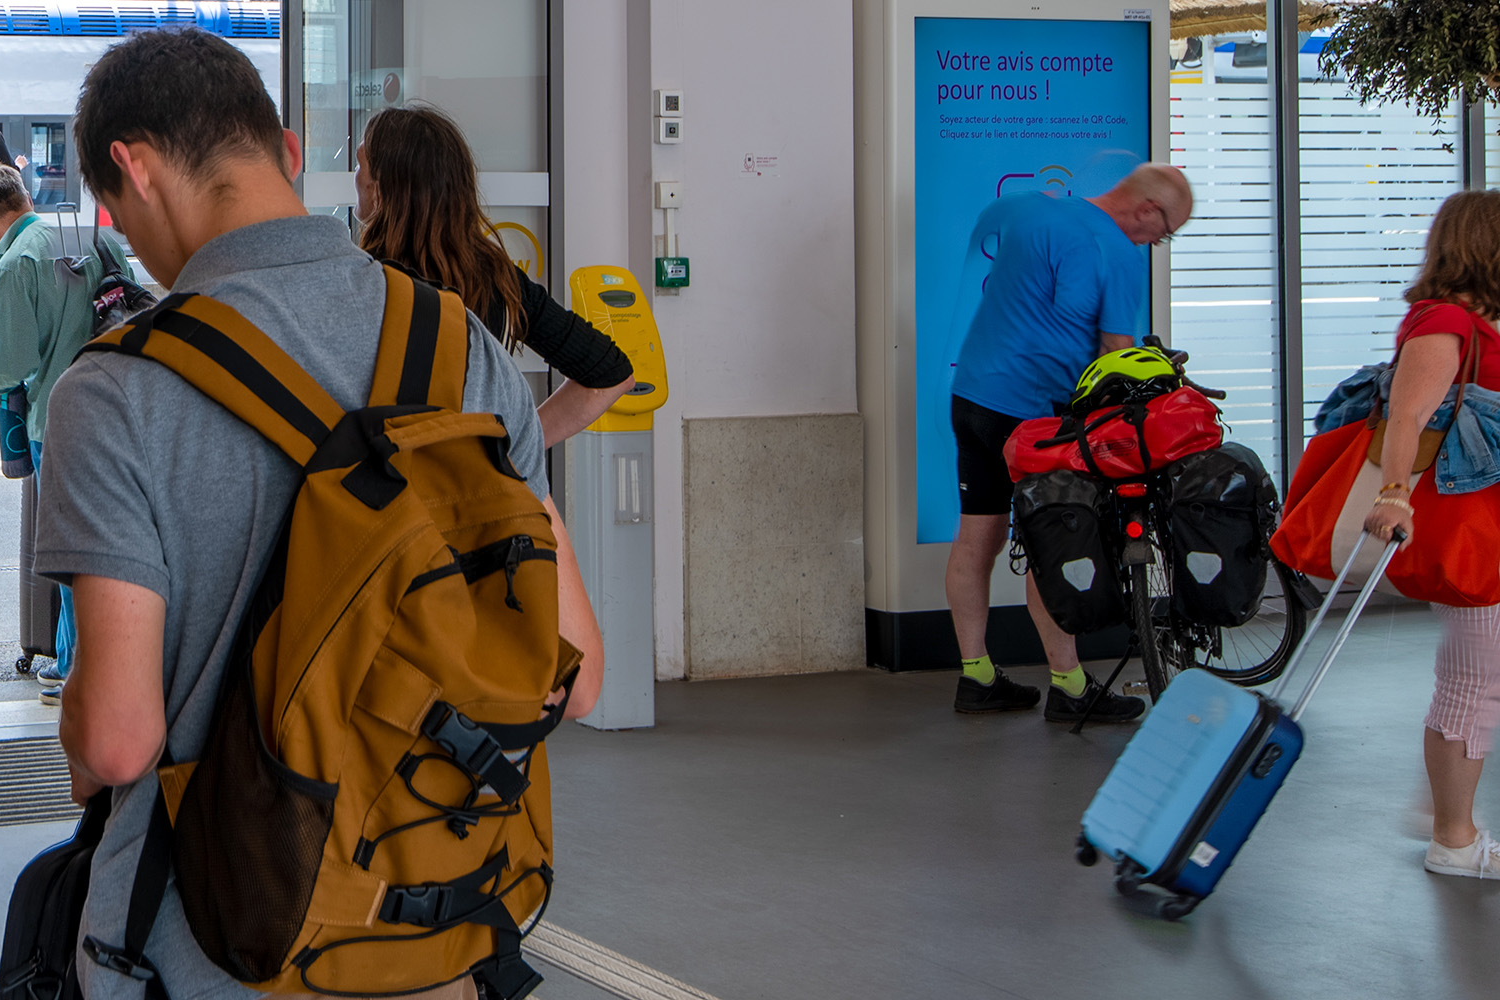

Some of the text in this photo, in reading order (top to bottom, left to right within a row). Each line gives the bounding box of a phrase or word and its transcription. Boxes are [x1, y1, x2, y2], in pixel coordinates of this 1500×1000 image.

[937, 50, 1113, 76] Votre avis compte
[937, 82, 1037, 104] pour nous
[940, 114, 962, 127] Soyez
[965, 116, 989, 124] acteur
[991, 115, 1001, 124] de
[1026, 117, 1043, 126] gare
[1082, 115, 1089, 124] le
[1091, 115, 1103, 124] QR
[1105, 115, 1128, 125] Code,
[940, 129, 969, 141] Cliquez
[985, 129, 992, 138] le
[994, 129, 1007, 138] lien
[1020, 129, 1069, 139] donnez-nous
[1092, 130, 1107, 138] avis
